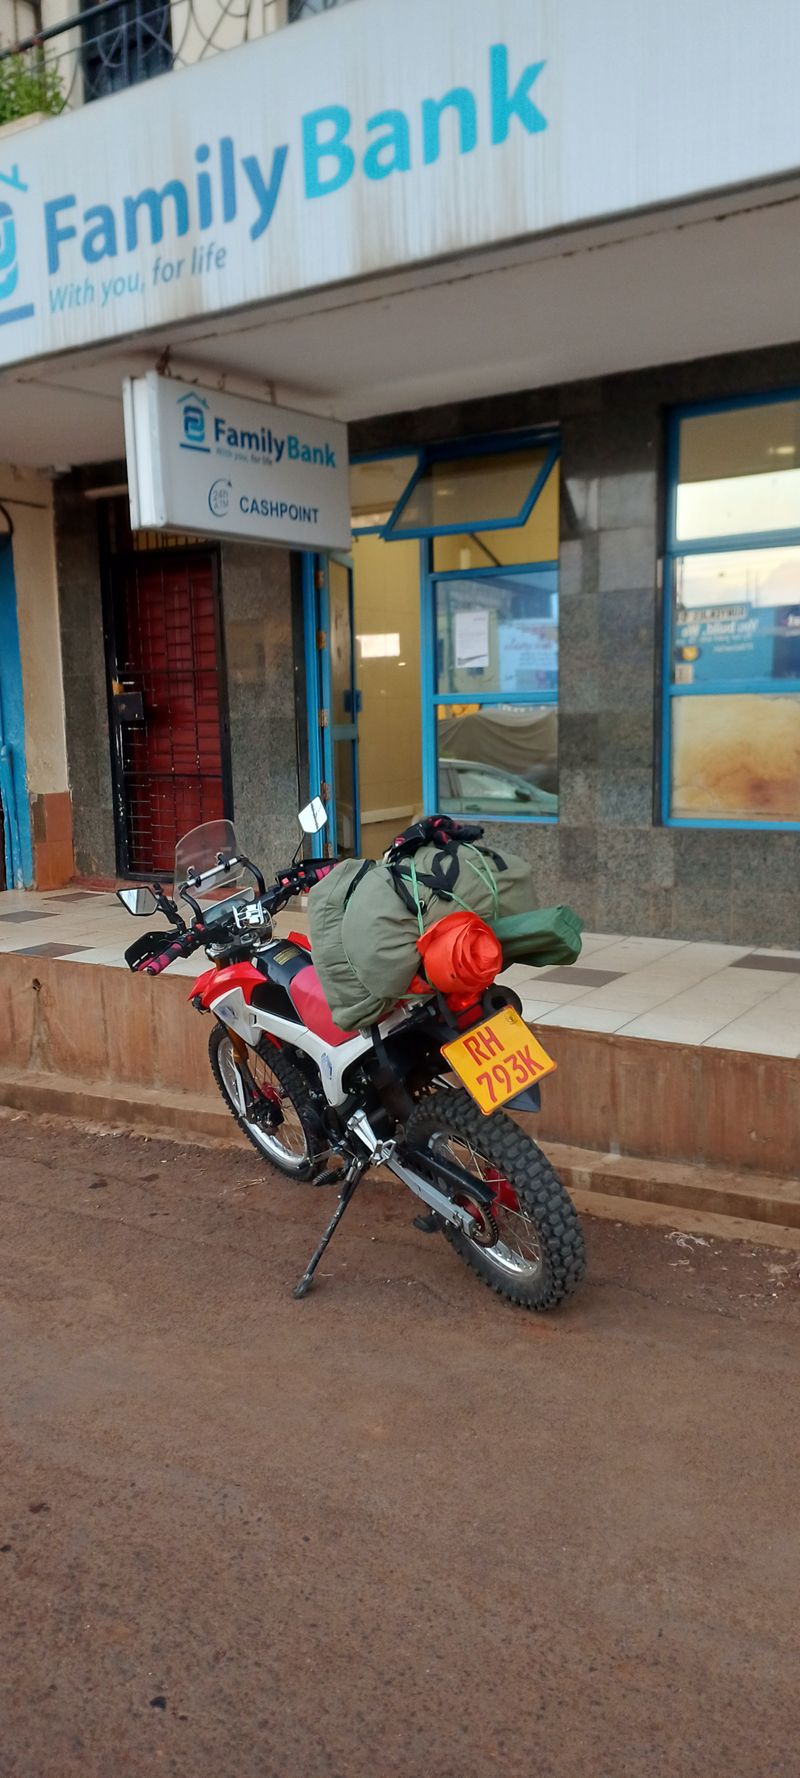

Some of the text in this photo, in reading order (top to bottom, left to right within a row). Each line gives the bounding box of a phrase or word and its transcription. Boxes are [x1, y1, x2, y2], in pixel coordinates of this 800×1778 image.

[49, 241, 227, 313] With you, for life
[239, 496, 319, 523] CASHPOINT
[462, 1026, 505, 1067] RH
[476, 1044, 545, 1103] 793K
